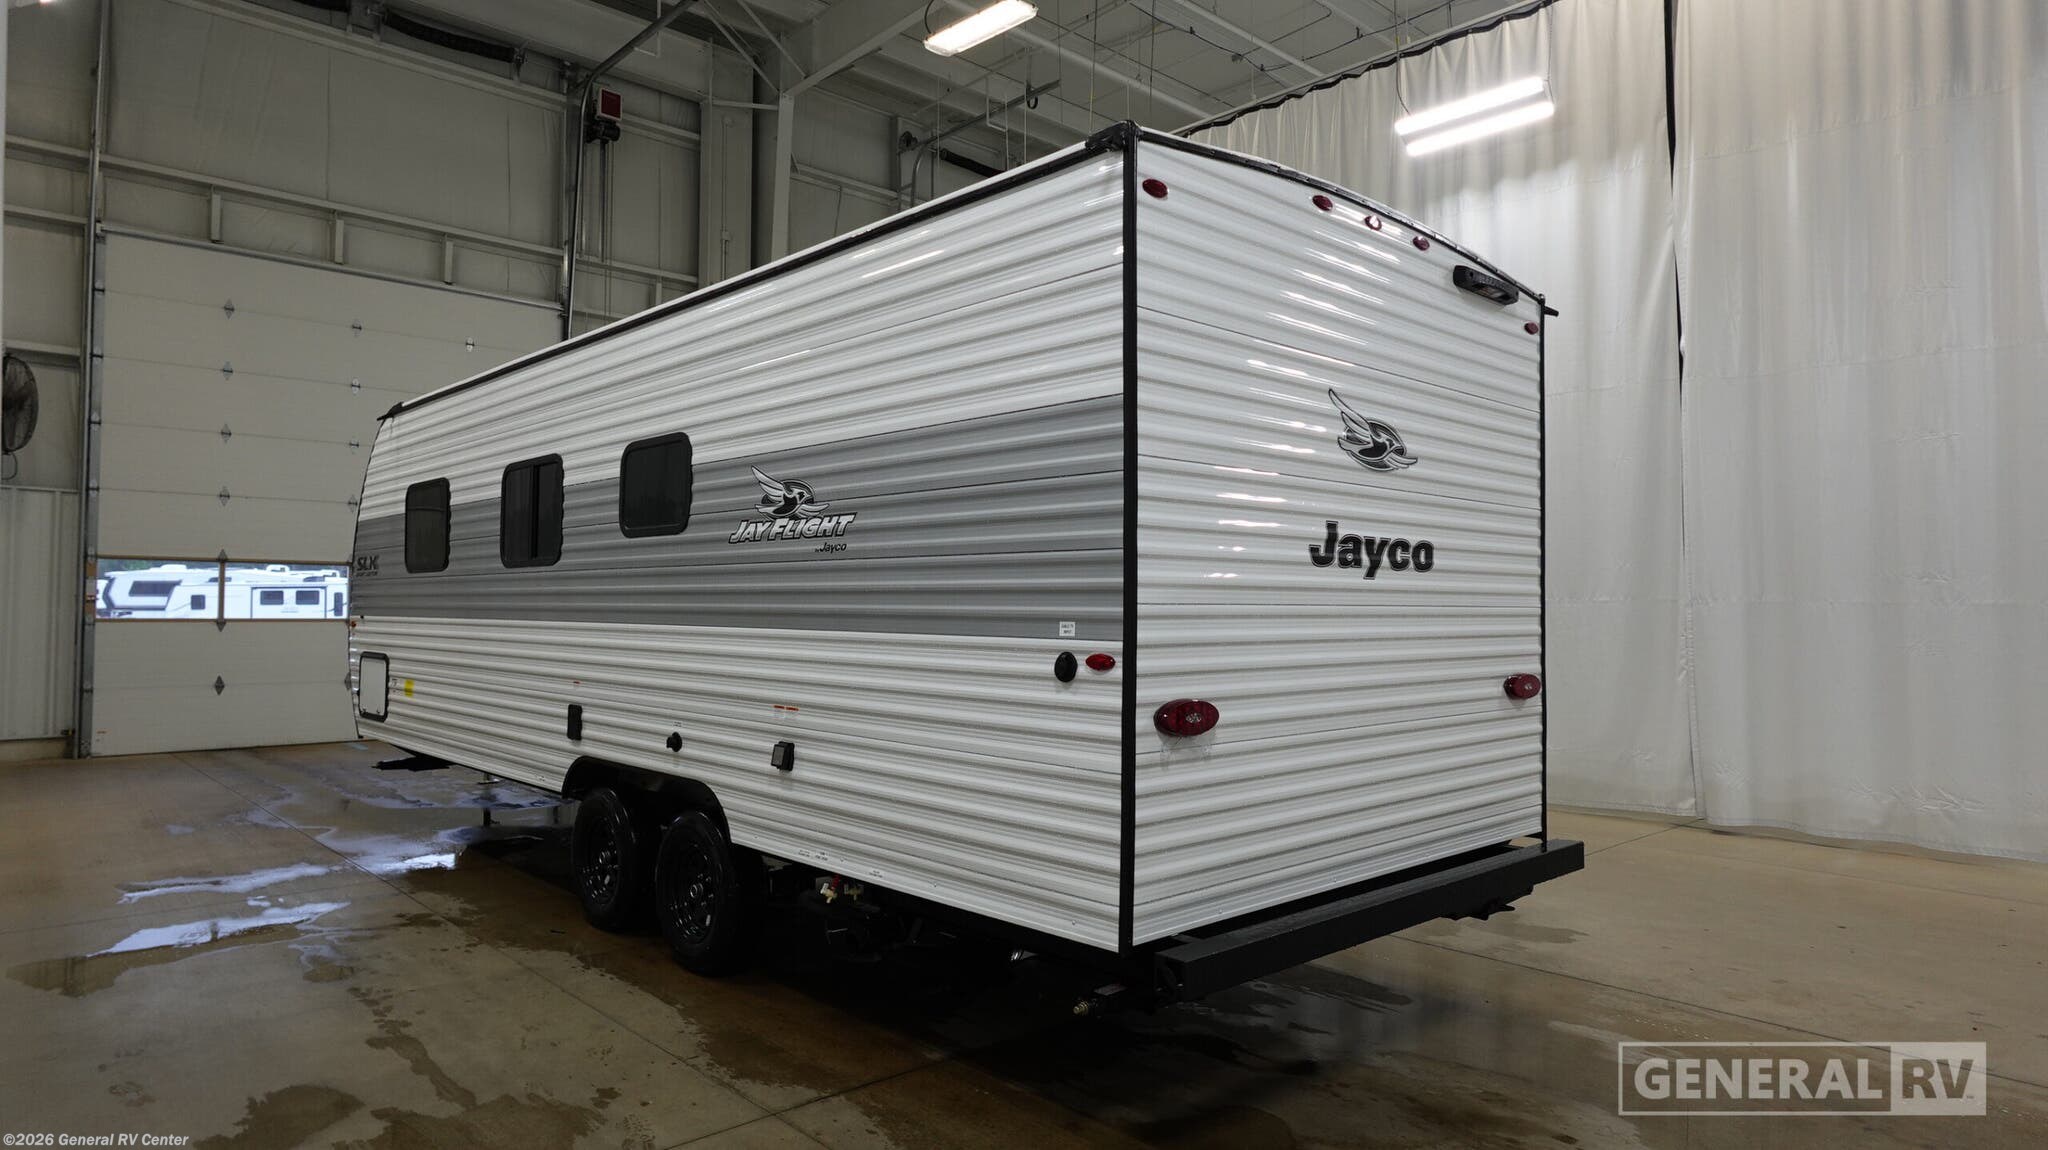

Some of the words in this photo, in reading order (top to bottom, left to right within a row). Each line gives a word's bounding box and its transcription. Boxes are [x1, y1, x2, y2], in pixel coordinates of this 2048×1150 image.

[728, 520, 773, 544] JAY
[767, 512, 857, 541] FLIGHT
[820, 542, 847, 554] Jayco
[1309, 520, 1435, 580] Jayco
